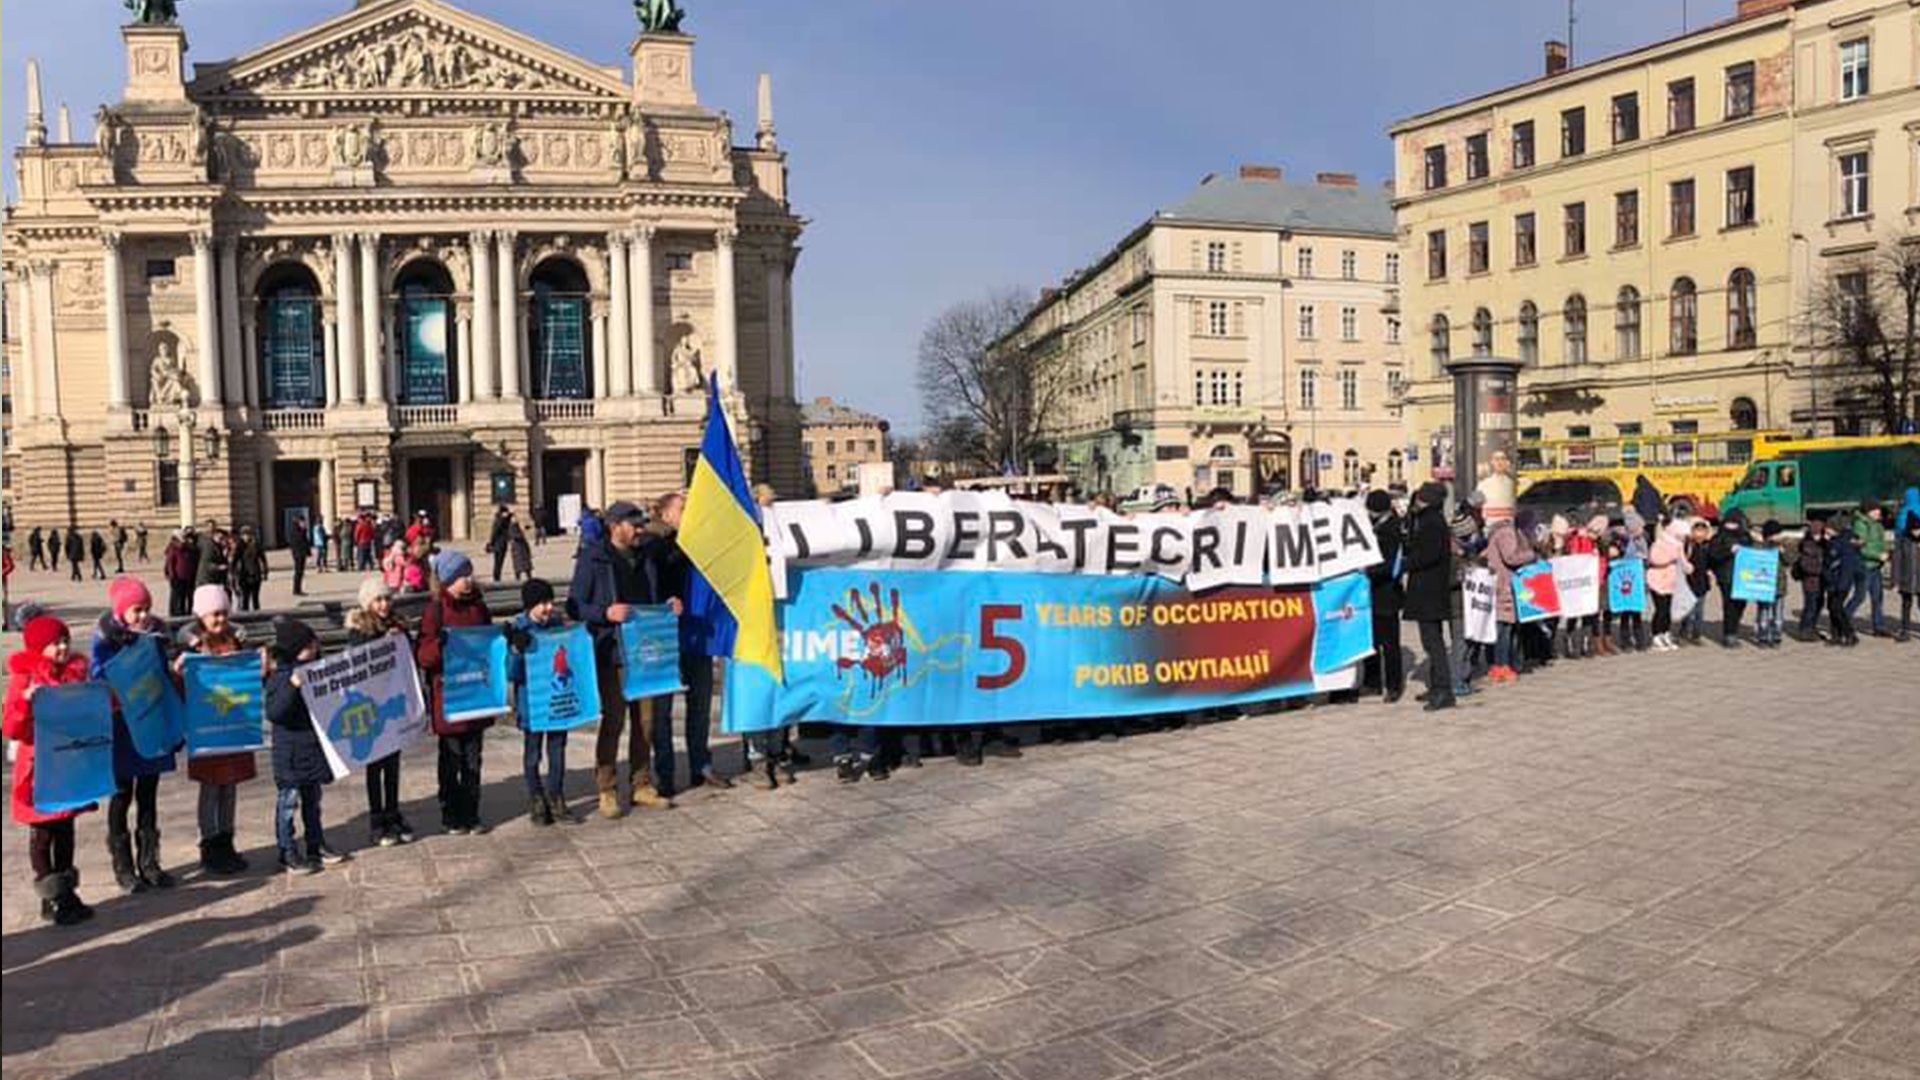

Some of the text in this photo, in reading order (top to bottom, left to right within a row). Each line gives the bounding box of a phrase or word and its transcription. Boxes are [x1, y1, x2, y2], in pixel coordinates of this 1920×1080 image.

[1036, 603, 1112, 626] YEARS
[1119, 604, 1147, 626] OF
[1154, 596, 1304, 626] OCCUPATION
[975, 604, 1027, 691] 5
[1075, 650, 1271, 688] РОКІВ ОКУПАЦІЇ
